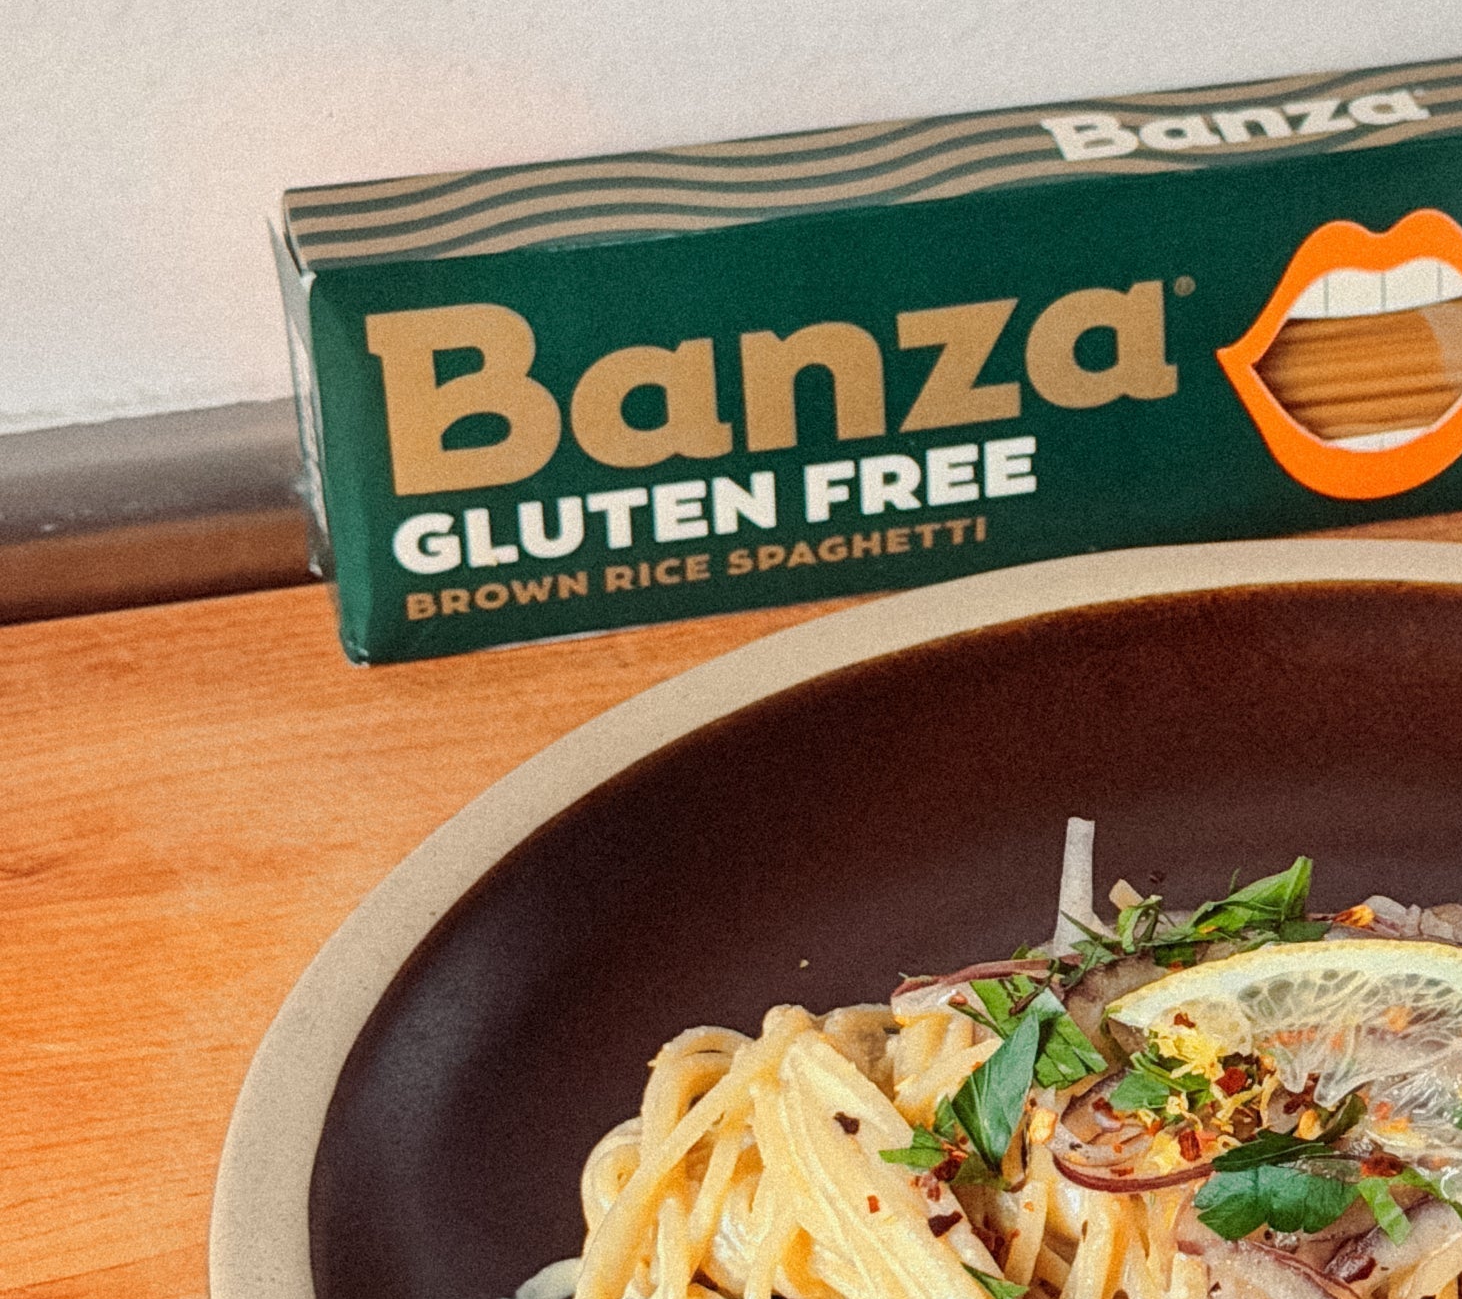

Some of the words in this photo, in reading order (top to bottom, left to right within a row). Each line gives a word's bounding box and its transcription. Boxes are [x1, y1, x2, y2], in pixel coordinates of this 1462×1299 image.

[1041, 89, 1432, 162] Banza
[365, 278, 1178, 497] Banza
[392, 469, 778, 577] GLUTEN
[803, 436, 1038, 523] FREE
[405, 570, 590, 622] BROWN
[604, 555, 712, 595] RICE
[727, 515, 988, 577] SPAGHETTI
